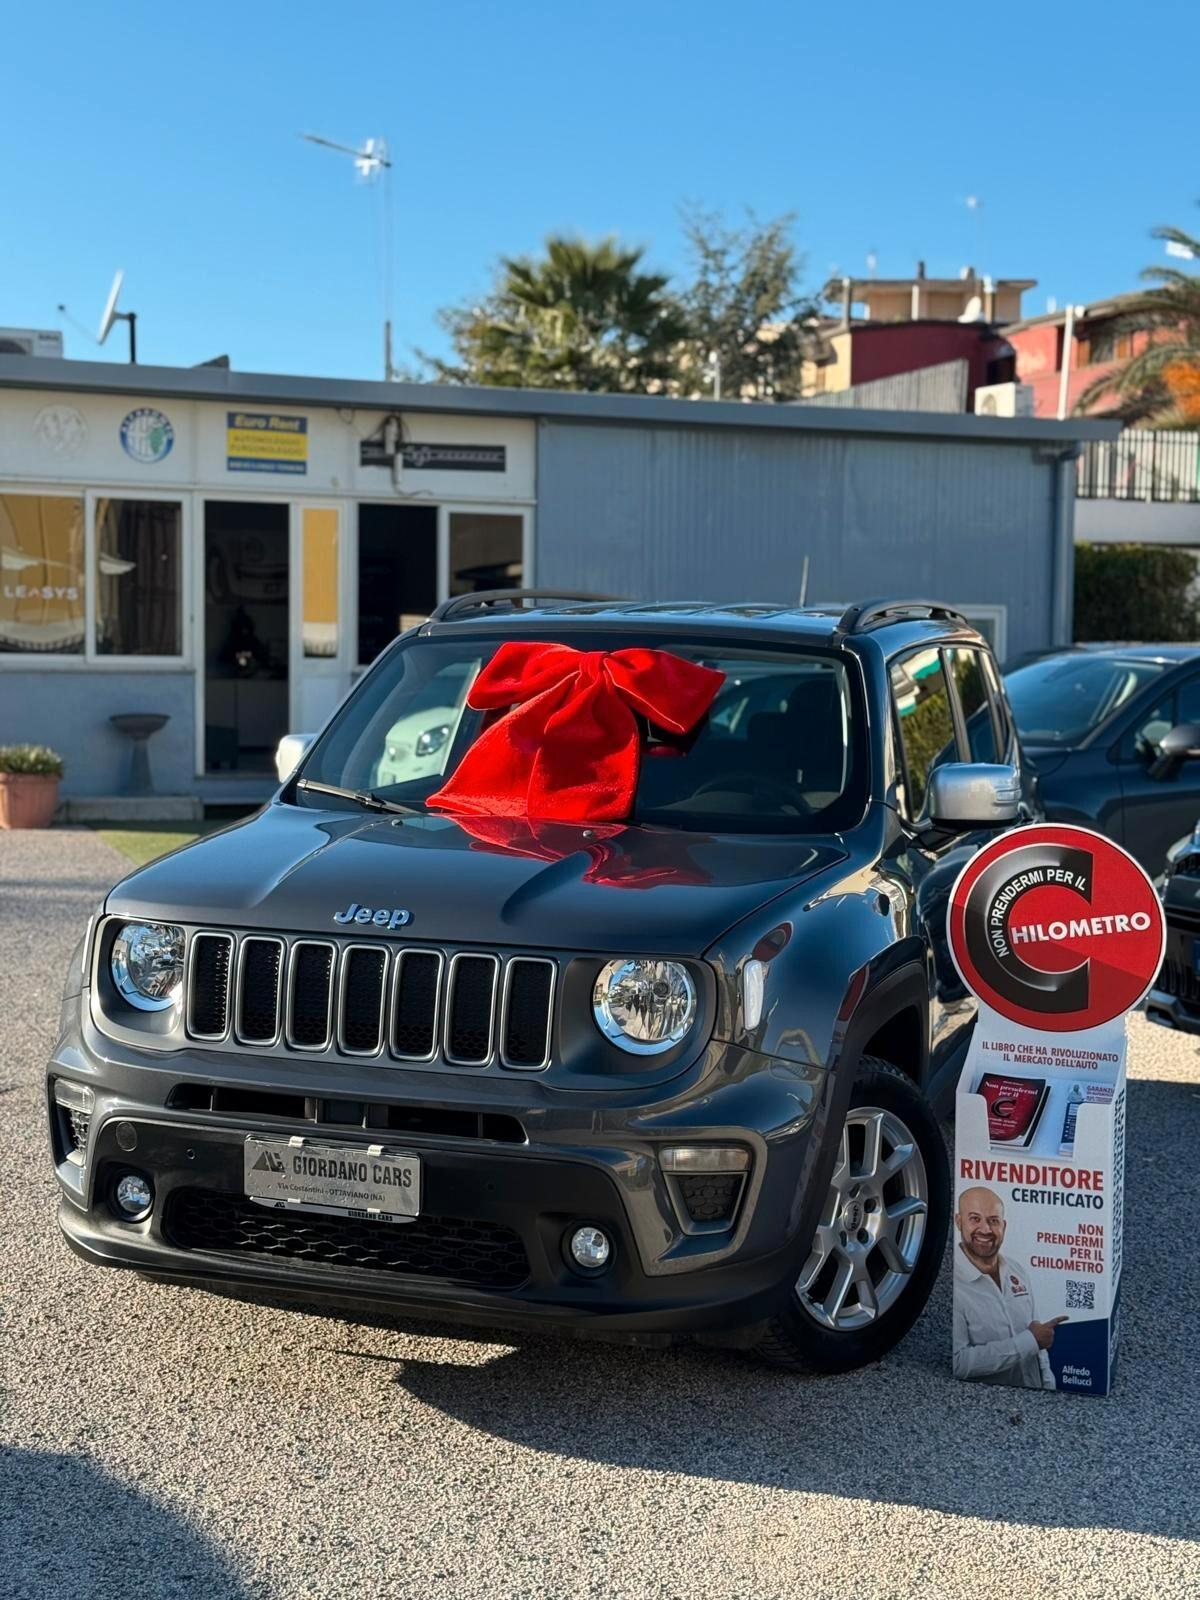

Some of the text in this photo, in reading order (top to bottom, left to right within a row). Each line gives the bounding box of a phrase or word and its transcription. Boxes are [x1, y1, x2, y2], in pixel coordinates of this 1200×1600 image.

[235, 415, 300, 430] Euro Rent
[4, 585, 78, 600] LEASYS
[333, 903, 410, 929] Jeep
[991, 869, 1086, 958] NON PRENDERMI PER IL
[1011, 911, 1151, 944] HILOMETRO
[982, 1041, 1119, 1062] IL LIBRO CHE HA RIVOLUZIONATO
[1003, 1053, 1098, 1070] IL MERCATO DELL'AUTO
[292, 1155, 368, 1183] GIORDANO
[373, 1164, 412, 1188] CARS
[960, 1158, 1104, 1191] RIVENDITORE
[277, 1182, 386, 1202] Via Costantini OTTAVIANO (NA)
[1011, 1188, 1104, 1210] CERTIFICATO
[347, 1210, 393, 1221] GIORDANO CARS
[1078, 1223, 1104, 1236] NON
[1037, 1232, 1104, 1249] PRENDERMI
[1070, 1247, 1104, 1262] PER IL
[1030, 1255, 1104, 1274] CHILOMETRO
[1062, 1365, 1091, 1377] Alfredo
[1063, 1375, 1092, 1387] Bellucci
